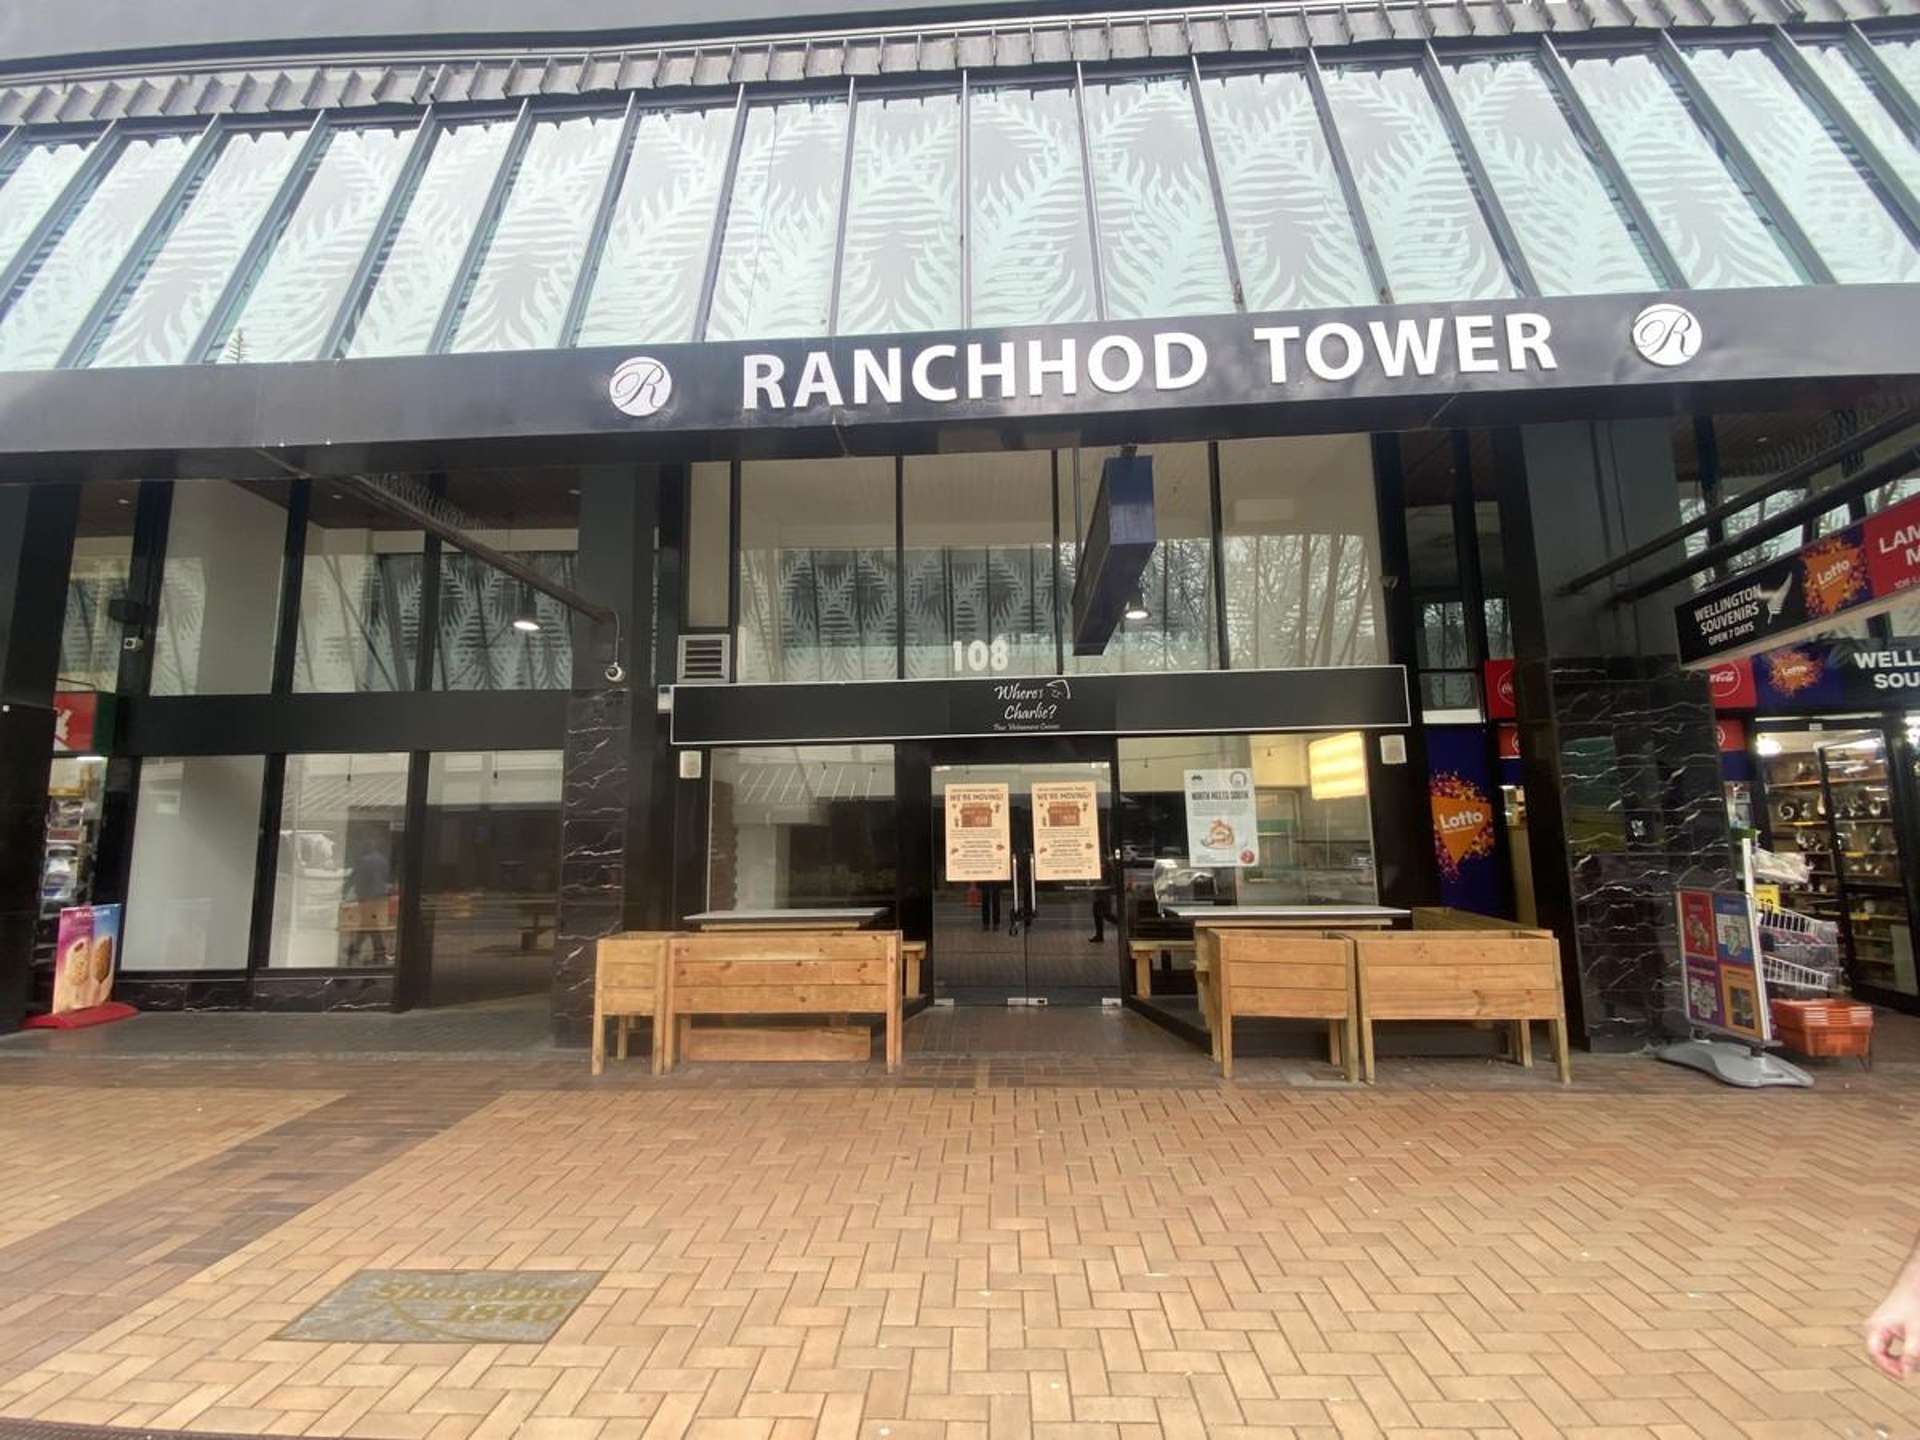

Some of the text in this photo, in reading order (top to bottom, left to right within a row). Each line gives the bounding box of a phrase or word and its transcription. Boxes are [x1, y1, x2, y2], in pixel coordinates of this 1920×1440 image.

[742, 312, 1558, 410] RANCHHOD TOWER
[1816, 560, 1850, 586] Lotto
[1694, 583, 1761, 622] WELLINGTON
[1700, 601, 1760, 636] SOUVENIRS
[1708, 621, 1754, 646] OPEN 7 DAYS
[953, 639, 1008, 671] 108
[1854, 651, 1920, 669] WELL
[1873, 672, 1920, 688] SOU
[1440, 810, 1484, 830] Lotto
